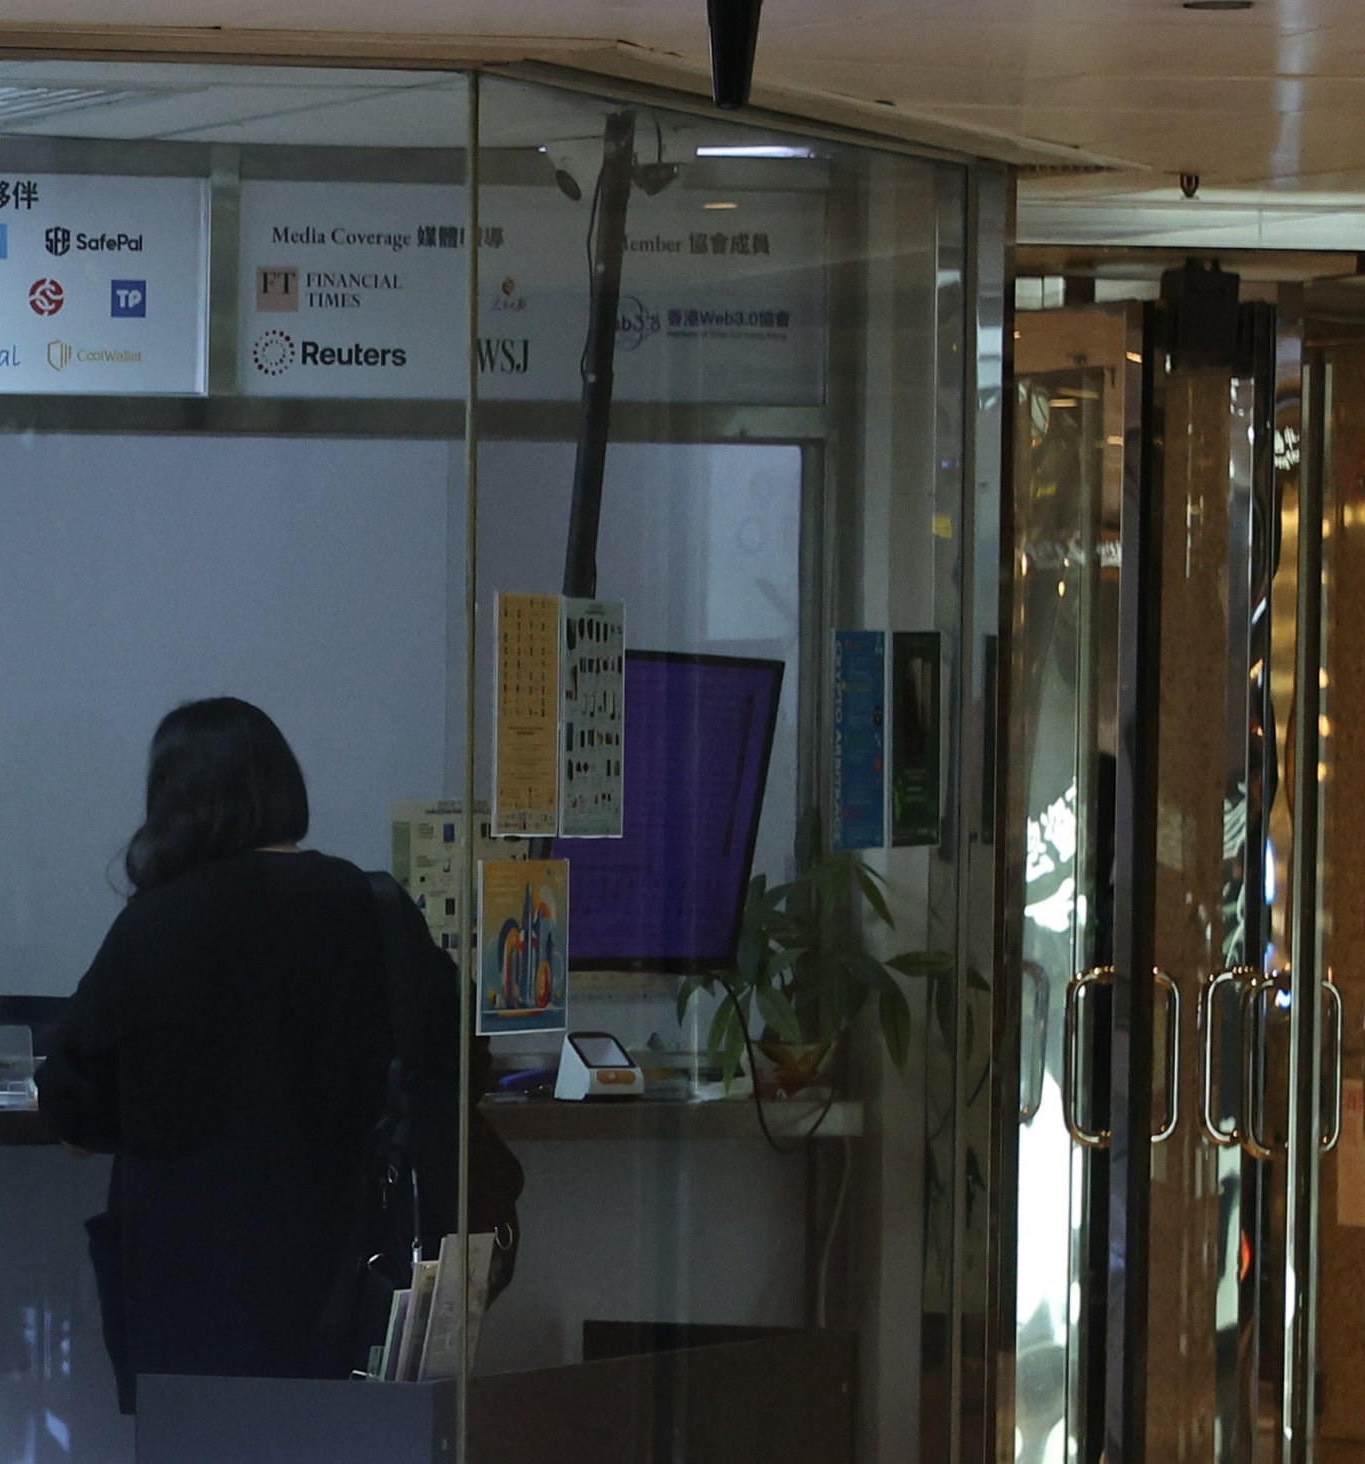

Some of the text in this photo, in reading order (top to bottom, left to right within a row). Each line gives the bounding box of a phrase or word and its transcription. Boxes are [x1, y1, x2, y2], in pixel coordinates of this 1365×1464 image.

[76, 232, 143, 252] SafePal
[271, 226, 326, 245] Media
[331, 227, 412, 252] Coverage
[260, 271, 296, 295] FT
[305, 272, 403, 290] FINANCIAL
[308, 292, 361, 309] TIMES
[301, 341, 407, 367] Reuters
[477, 338, 530, 374] WSJ
